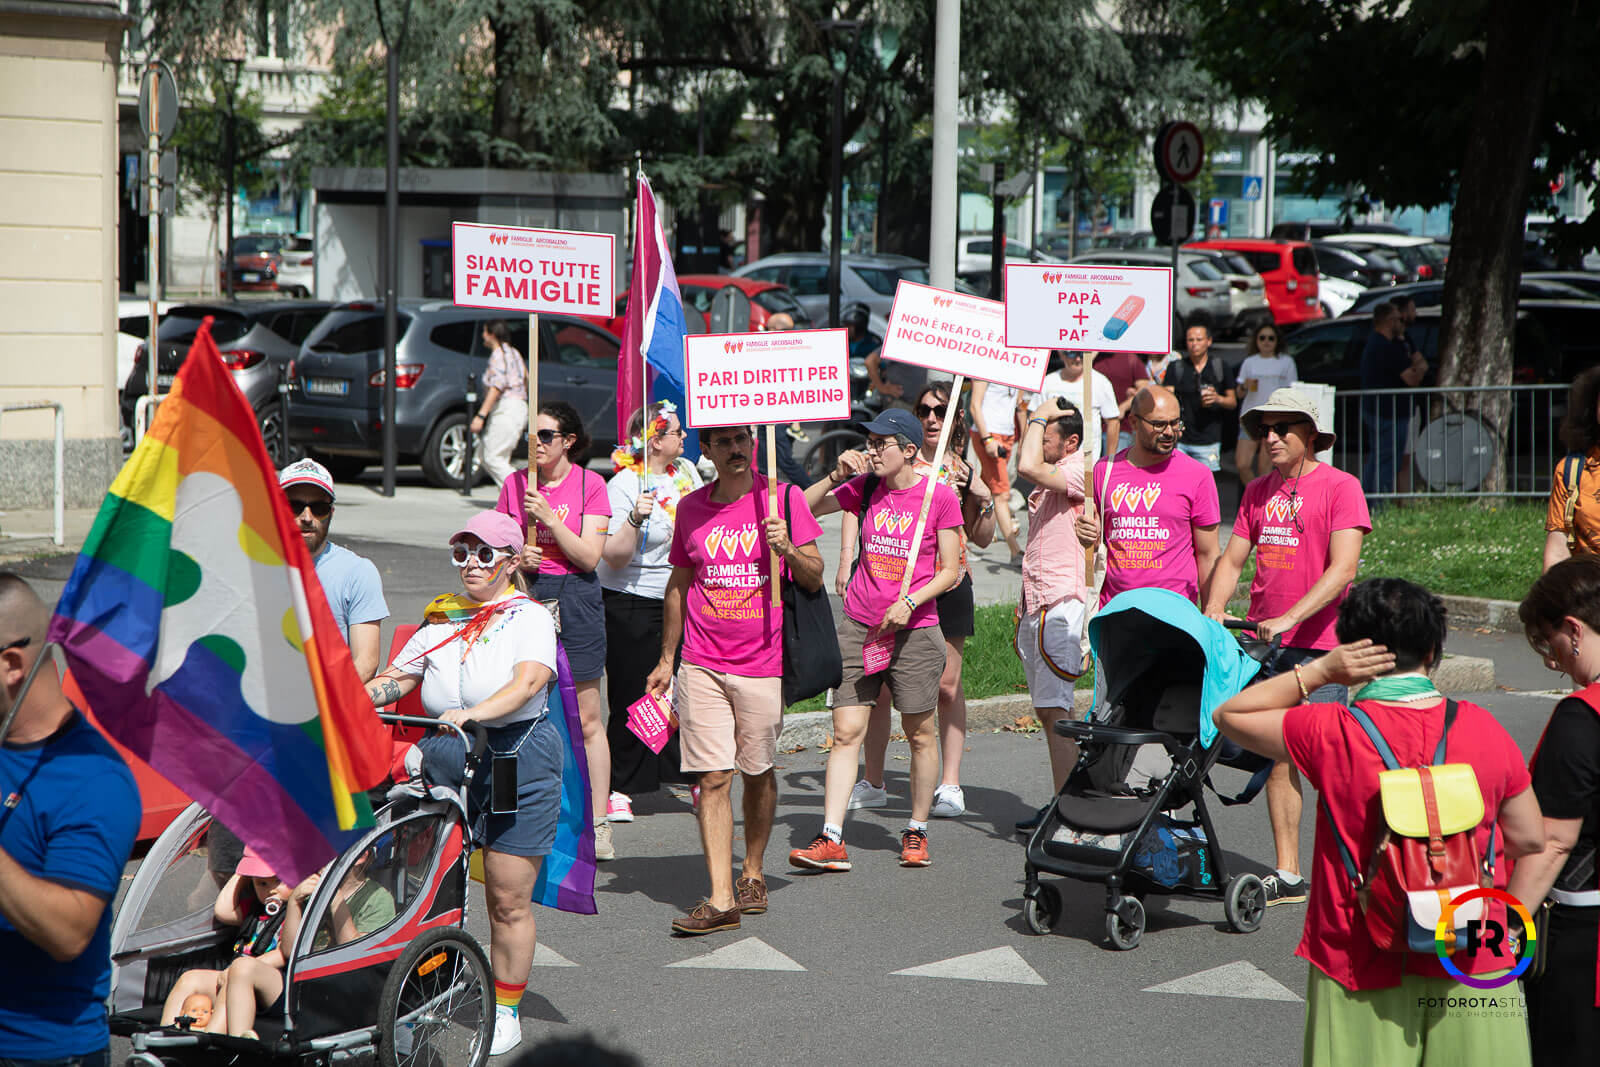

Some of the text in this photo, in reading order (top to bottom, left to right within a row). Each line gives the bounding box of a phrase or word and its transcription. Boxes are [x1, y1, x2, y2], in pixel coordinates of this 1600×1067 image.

[466, 254, 600, 280] SIAMO TUTTE
[466, 274, 600, 306] FAMIGLIE
[1058, 289, 1102, 306] PAPÀ
[901, 313, 995, 342] NON È REATO, È
[896, 327, 1038, 369] INCONDIZIONATO!
[698, 366, 838, 387] PARI DIRITTI PER
[1112, 517, 1159, 529] FAMIGLIE
[871, 535, 909, 549] FAMIGLIE
[706, 563, 759, 577] FAMIGLIE
